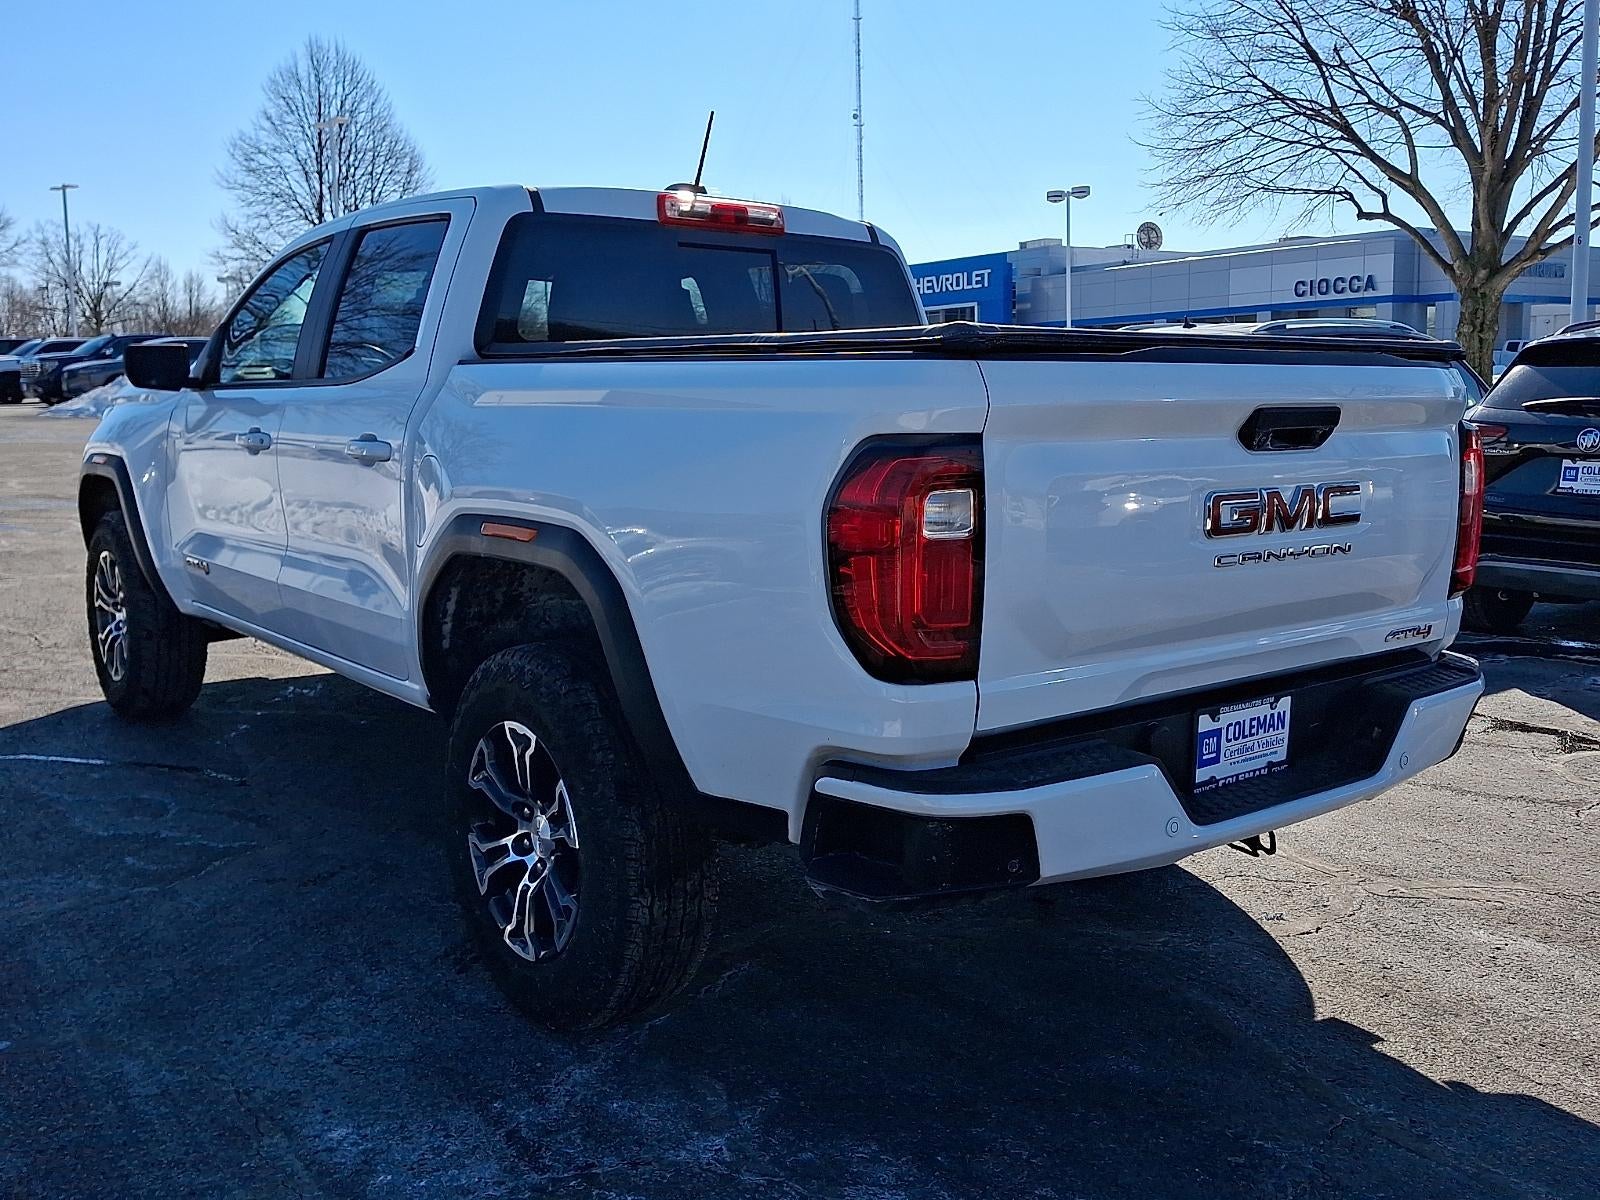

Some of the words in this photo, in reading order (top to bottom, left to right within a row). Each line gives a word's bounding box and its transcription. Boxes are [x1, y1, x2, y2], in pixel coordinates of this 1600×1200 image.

[913, 269, 991, 294] HEVROLET
[1293, 274, 1376, 298] CIOCCA
[1203, 479, 1361, 539] GMC
[1213, 542, 1352, 568] CANYON
[1384, 623, 1433, 643] AT4
[1225, 710, 1287, 743] COLEMAN
[1203, 737, 1217, 754] GM
[1224, 742, 1255, 759] Certified
[1256, 736, 1285, 750] Vehicles
